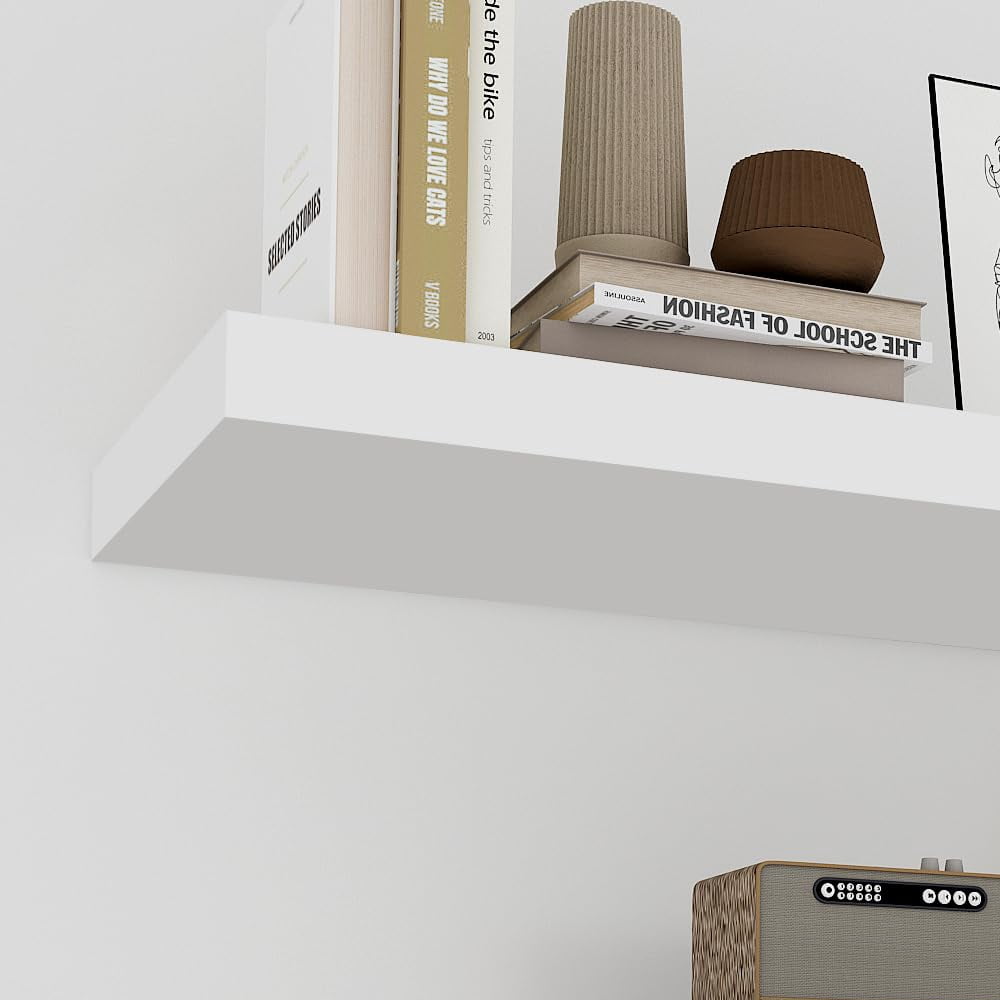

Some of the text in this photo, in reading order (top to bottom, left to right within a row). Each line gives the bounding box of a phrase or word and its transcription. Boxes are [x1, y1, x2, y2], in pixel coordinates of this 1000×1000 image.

[483, 29, 500, 66] the
[482, 72, 499, 120] bike
[425, 56, 449, 227] WHY DO WE LOVE CATS
[480, 137, 494, 226] tips and tricks
[268, 186, 321, 276] SELECTED STORIES
[423, 282, 440, 329] V BOOKS
[477, 331, 495, 342] 2003
